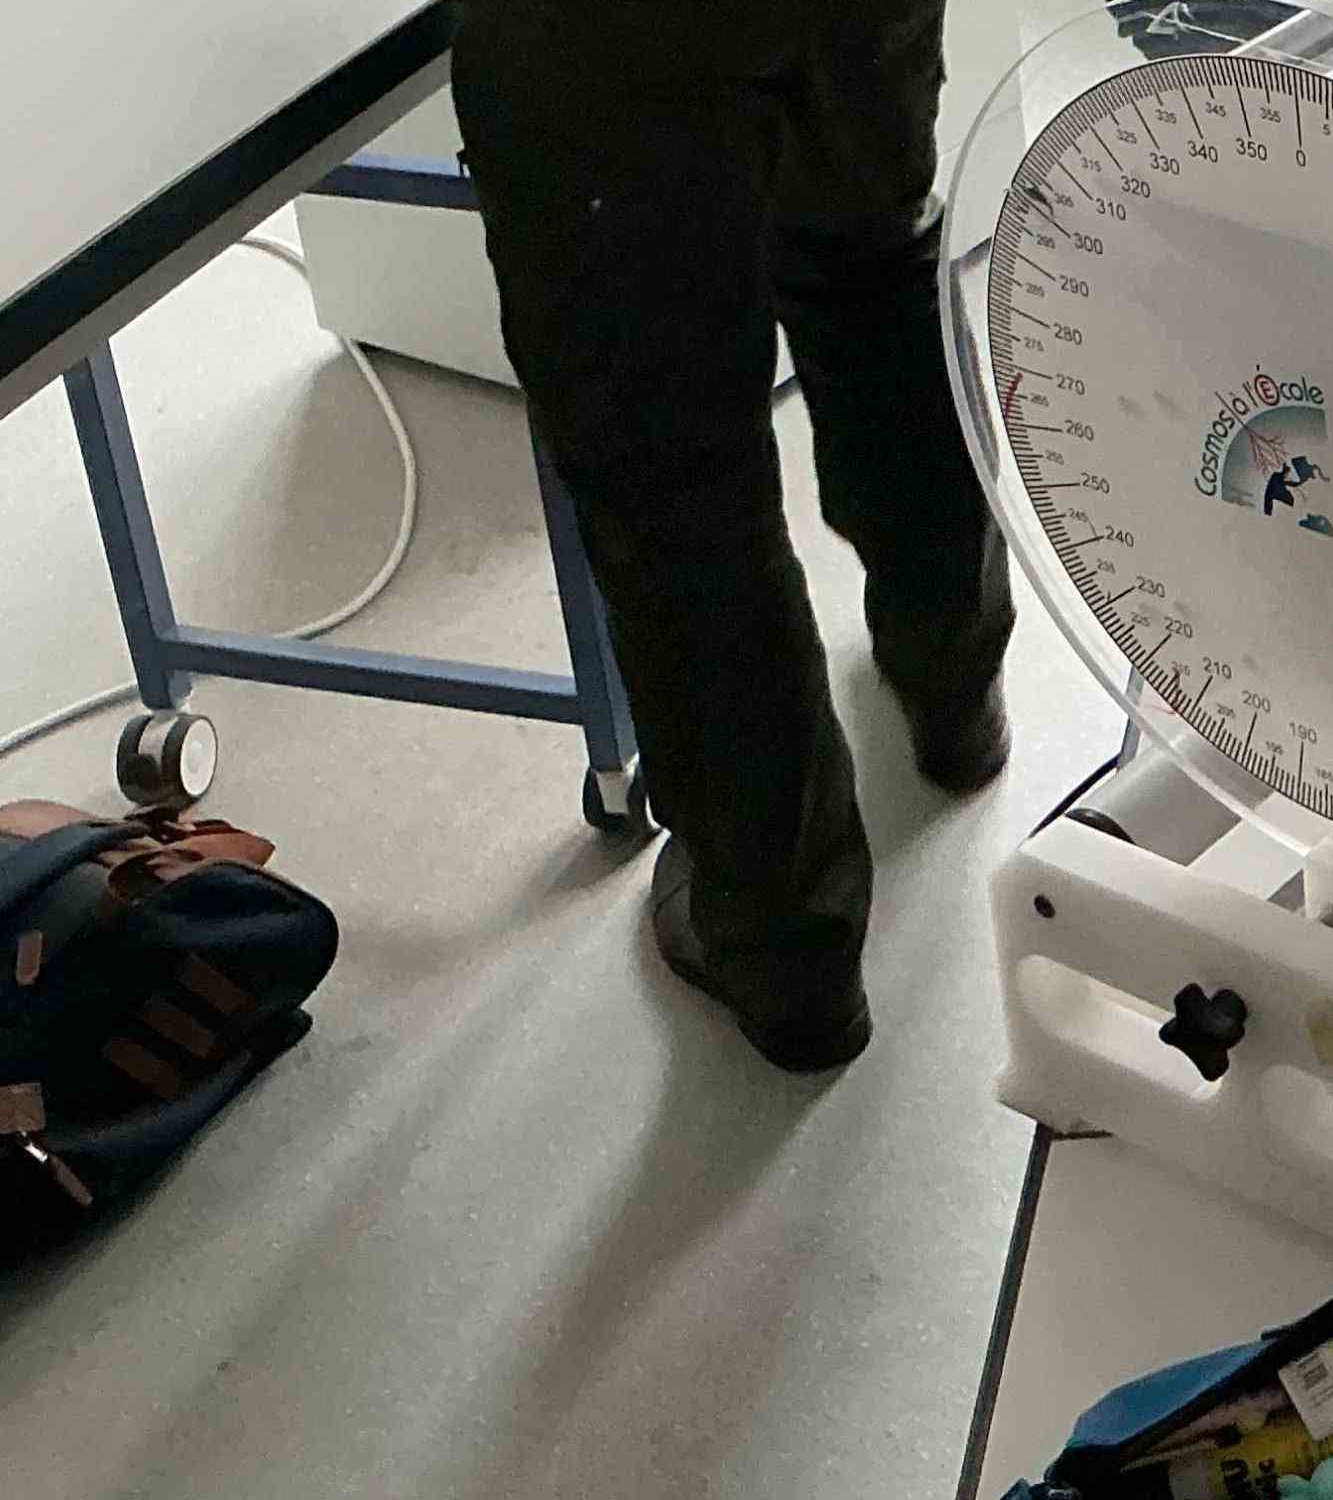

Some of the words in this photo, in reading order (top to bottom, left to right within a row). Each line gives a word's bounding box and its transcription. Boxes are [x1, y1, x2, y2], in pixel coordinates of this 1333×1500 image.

[1205, 101, 1226, 118] 345
[1323, 124, 1331, 135] 5
[1187, 141, 1218, 163] 340
[1235, 138, 1268, 161] 350
[1296, 150, 1306, 167] 0
[1149, 152, 1180, 175] 330
[1120, 176, 1150, 198] 320
[1096, 198, 1126, 221] 310
[1072, 233, 1104, 255] 300
[1059, 276, 1089, 297] 290
[1053, 323, 1083, 345] 280
[1056, 374, 1086, 395] 270
[1194, 409, 1236, 496] Cosmos
[1080, 473, 1110, 494] 250
[1105, 526, 1135, 547] 240
[1136, 576, 1166, 598] 230
[1163, 616, 1193, 639] 220
[1202, 657, 1232, 680] 210
[1241, 690, 1271, 713] 200
[1289, 722, 1318, 744] 190
